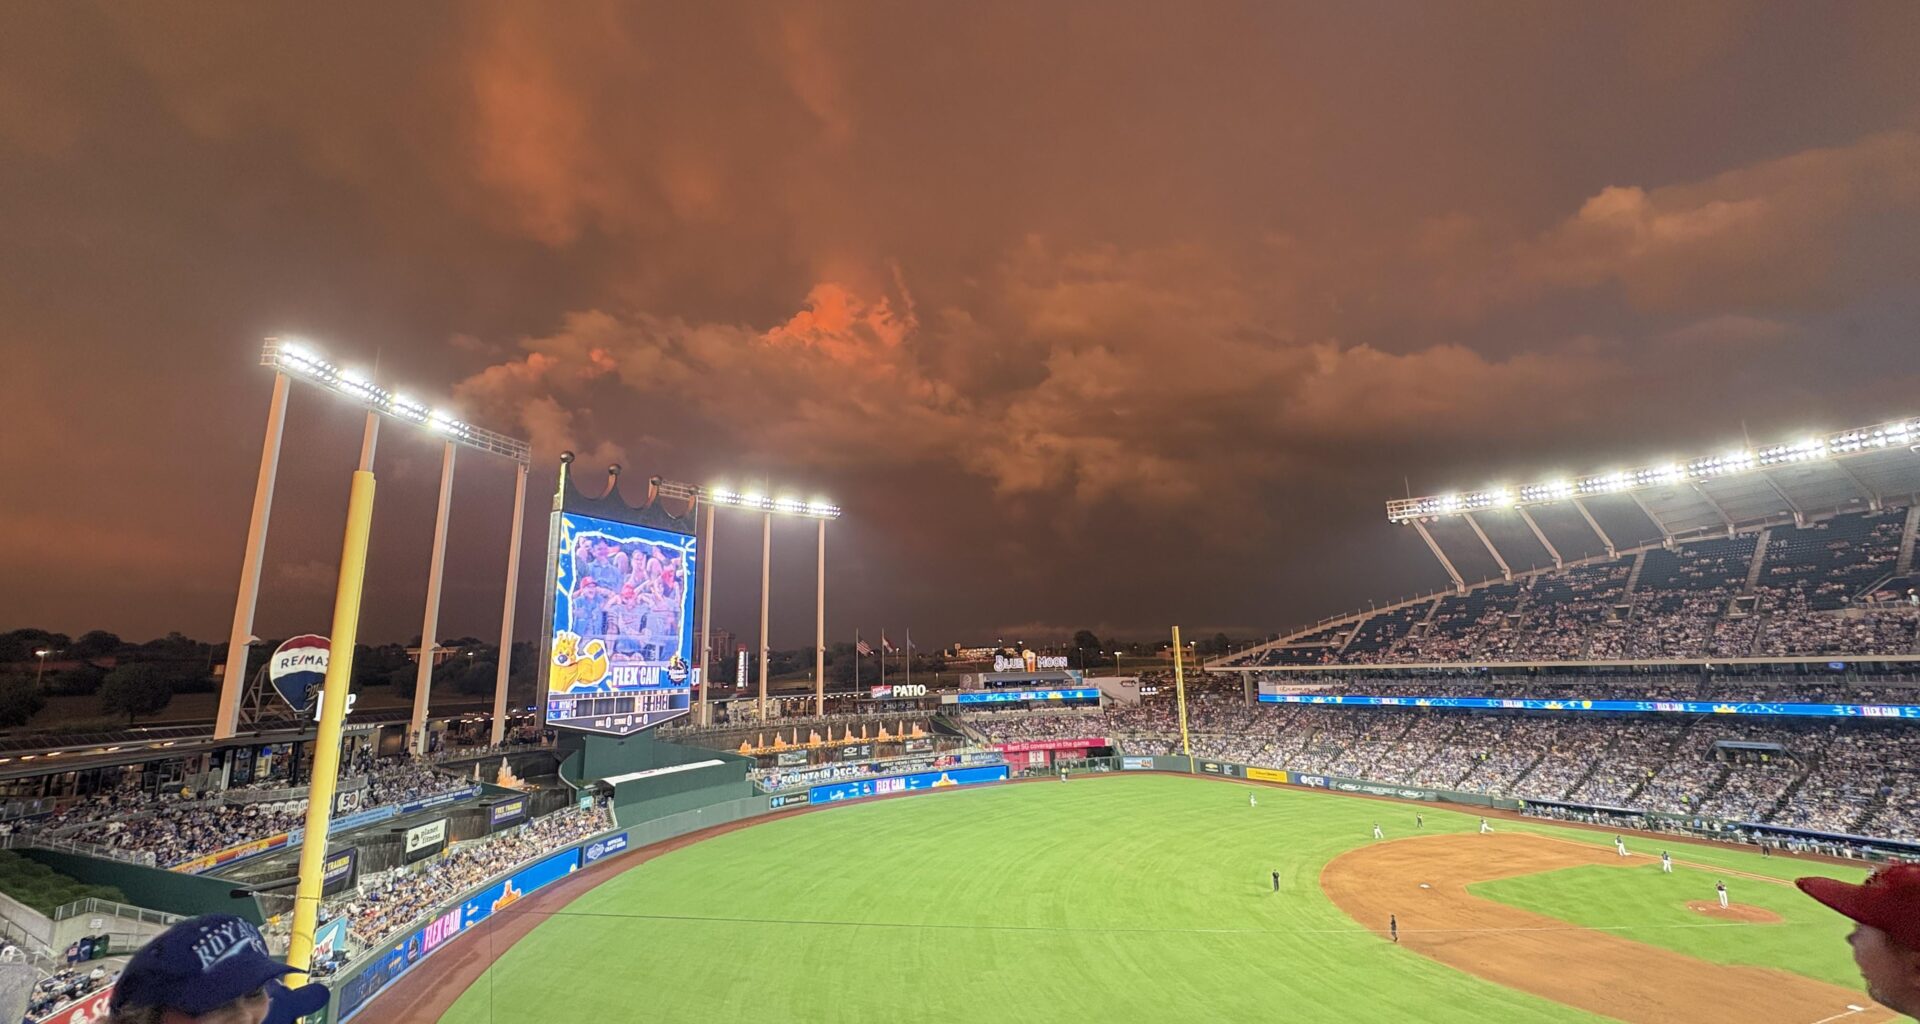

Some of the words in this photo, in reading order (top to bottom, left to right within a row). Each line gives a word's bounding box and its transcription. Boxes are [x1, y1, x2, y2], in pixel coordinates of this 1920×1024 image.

[994, 655, 1024, 672] BLUE
[1037, 656, 1068, 668] MOON
[613, 667, 639, 686] FLEX
[640, 666, 660, 685] CAM
[893, 684, 926, 697] PATIO
[1007, 743, 1020, 751] Best
[1030, 742, 1055, 750] coverage
[1073, 740, 1089, 748] game
[781, 770, 831, 785] FOUNTAIN
[833, 767, 860, 779] DECK
[876, 780, 891, 792] FLEX
[891, 778, 906, 790] CAM
[420, 825, 439, 839] planet
[422, 833, 440, 844] fitness
[423, 916, 445, 953] FLEX
[443, 908, 461, 938] CAM
